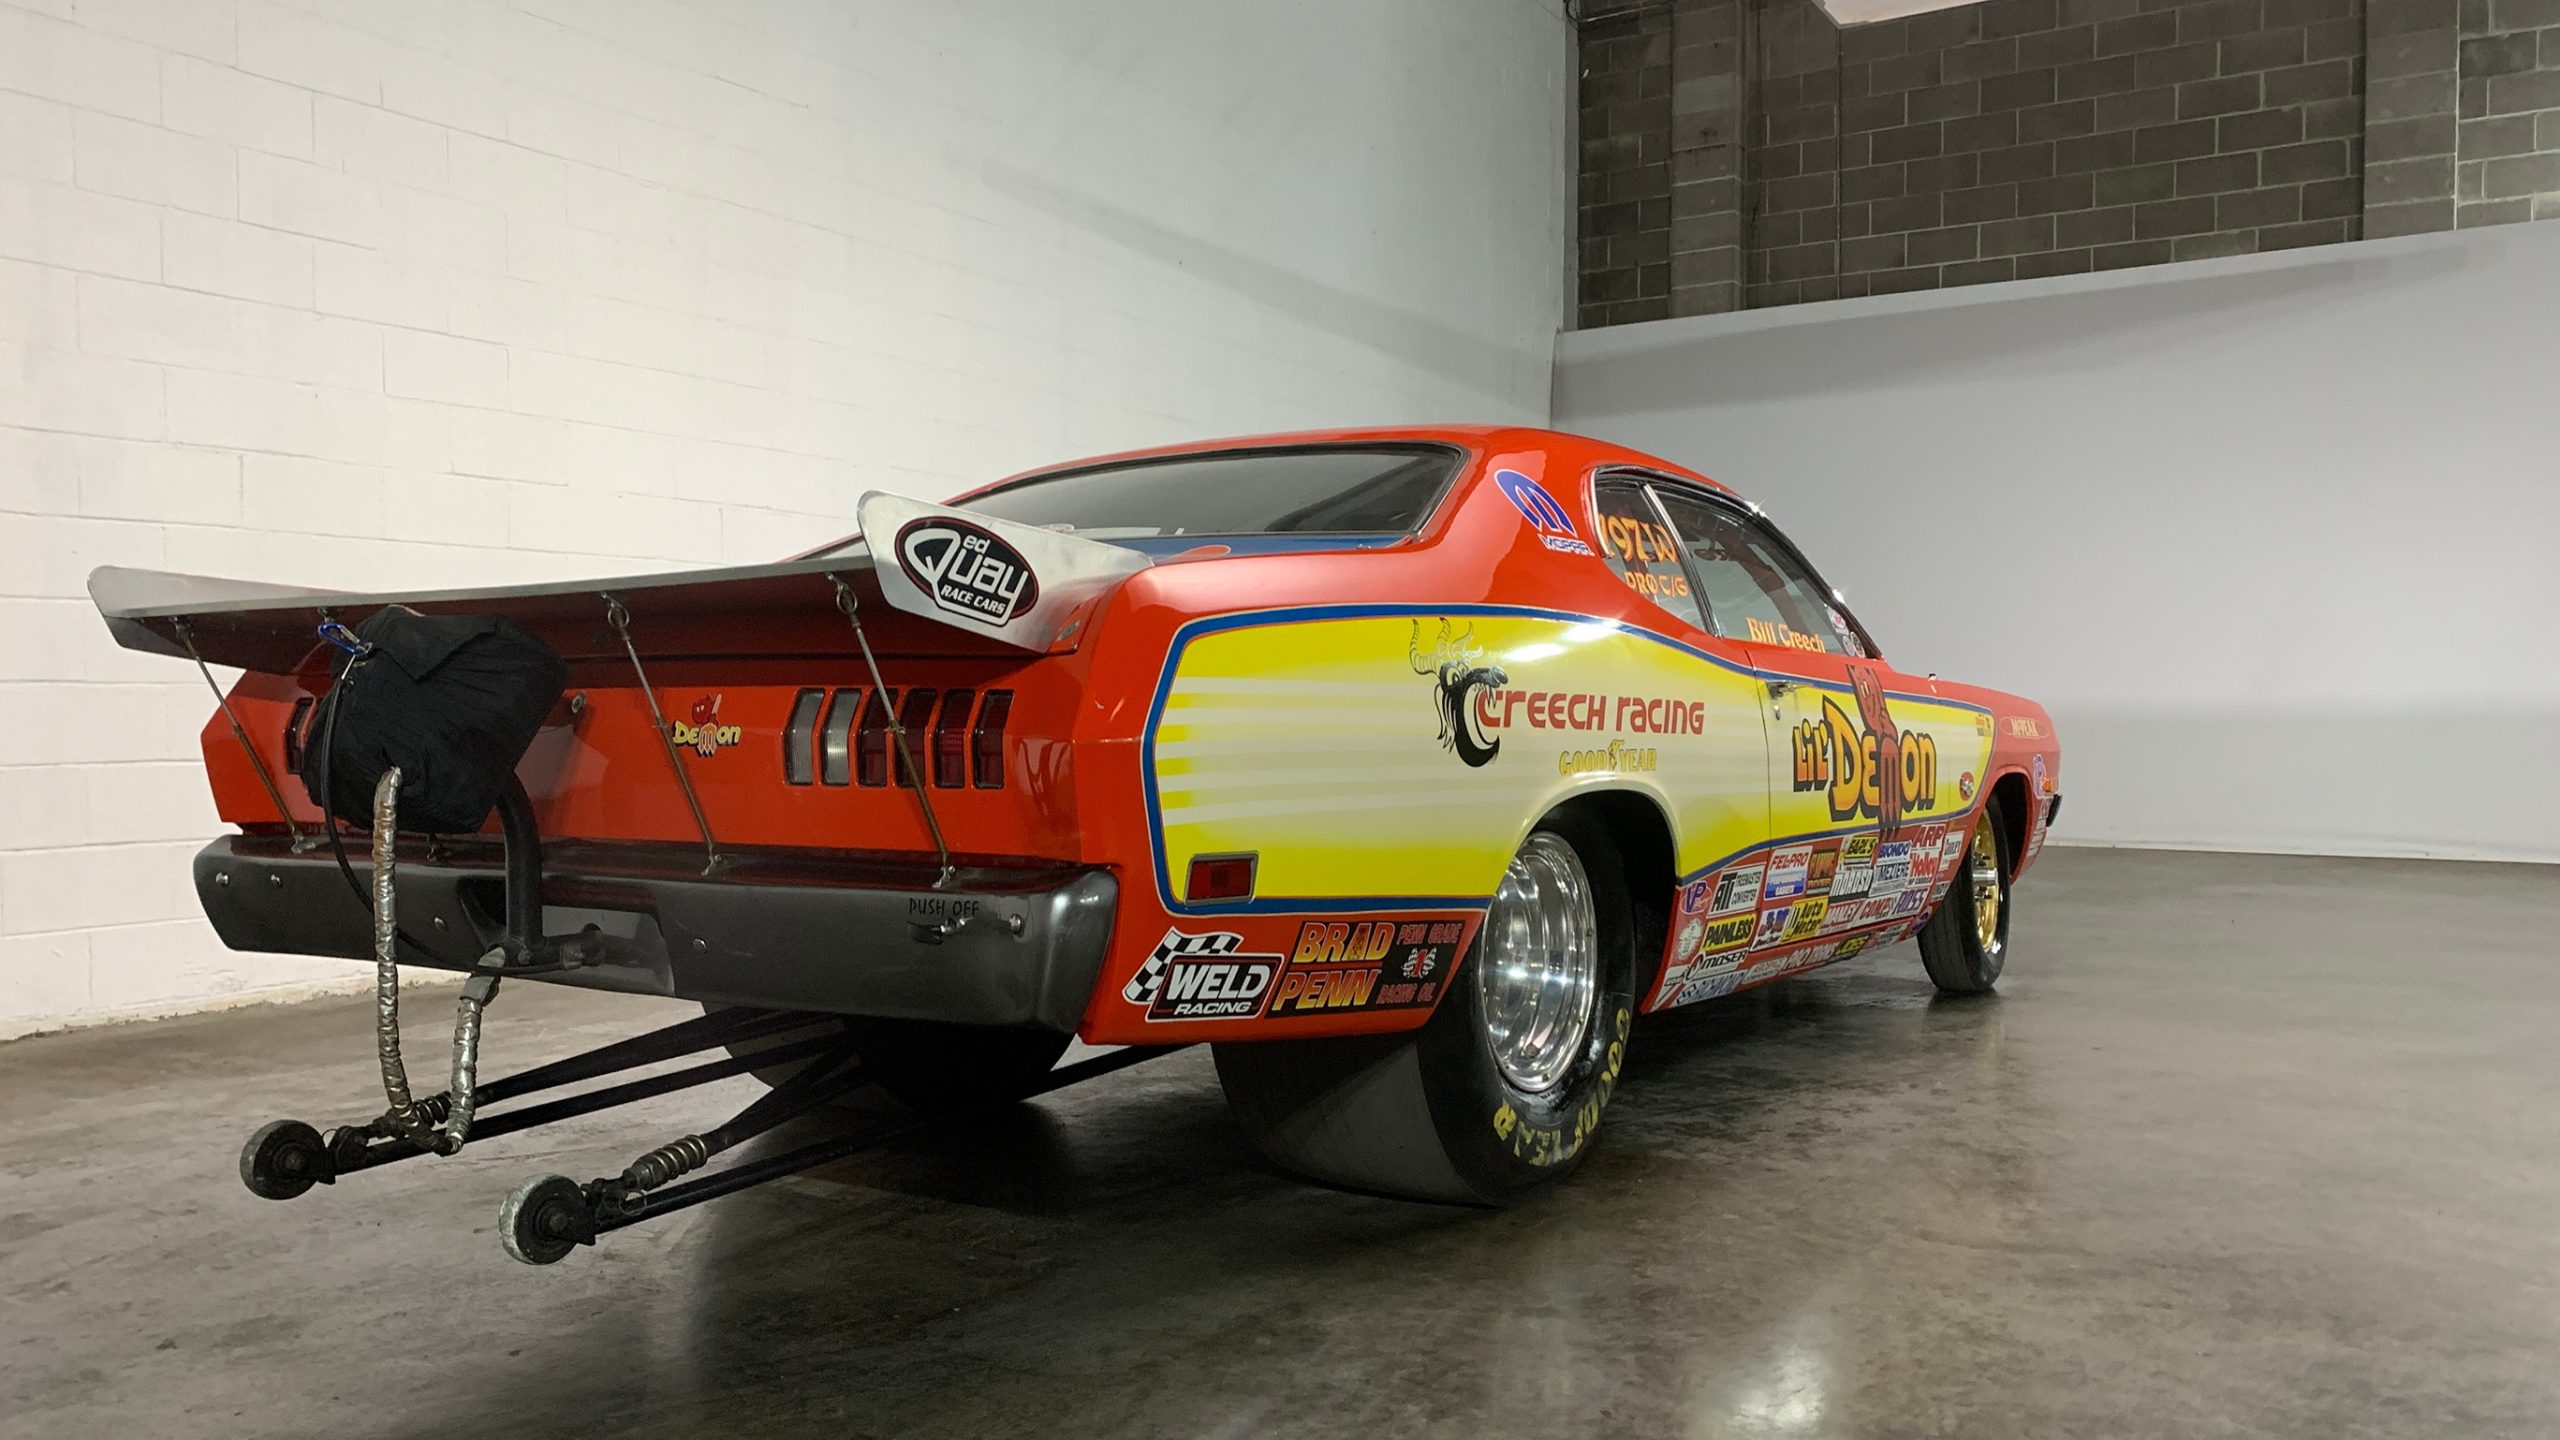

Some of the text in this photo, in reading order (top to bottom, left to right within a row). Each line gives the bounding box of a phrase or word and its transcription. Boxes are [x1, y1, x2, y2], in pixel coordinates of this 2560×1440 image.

[1538, 533, 1596, 557] MOPAR
[1624, 571, 1660, 595] PRO
[940, 583, 1007, 614] RACE CARS
[1745, 616, 1827, 654] Bill Creech
[1912, 825, 1946, 848] ARP
[1769, 852, 1810, 871] FEL-PRO
[1878, 842, 1910, 858] BIONDO
[1710, 872, 1738, 912] ATI
[1895, 888, 1928, 914] ROSS
[908, 897, 980, 917] PUSH OFF
[1800, 902, 1824, 919] Auto
[1292, 921, 1396, 963] BRAD
[1395, 922, 1463, 946] PENN GRADE
[1702, 917, 1754, 948] PAINLESS
[1166, 963, 1275, 1001] WELD
[1272, 969, 1380, 1012] PENN
[1376, 983, 1419, 1005] RACING
[1173, 1001, 1252, 1017] RACING
